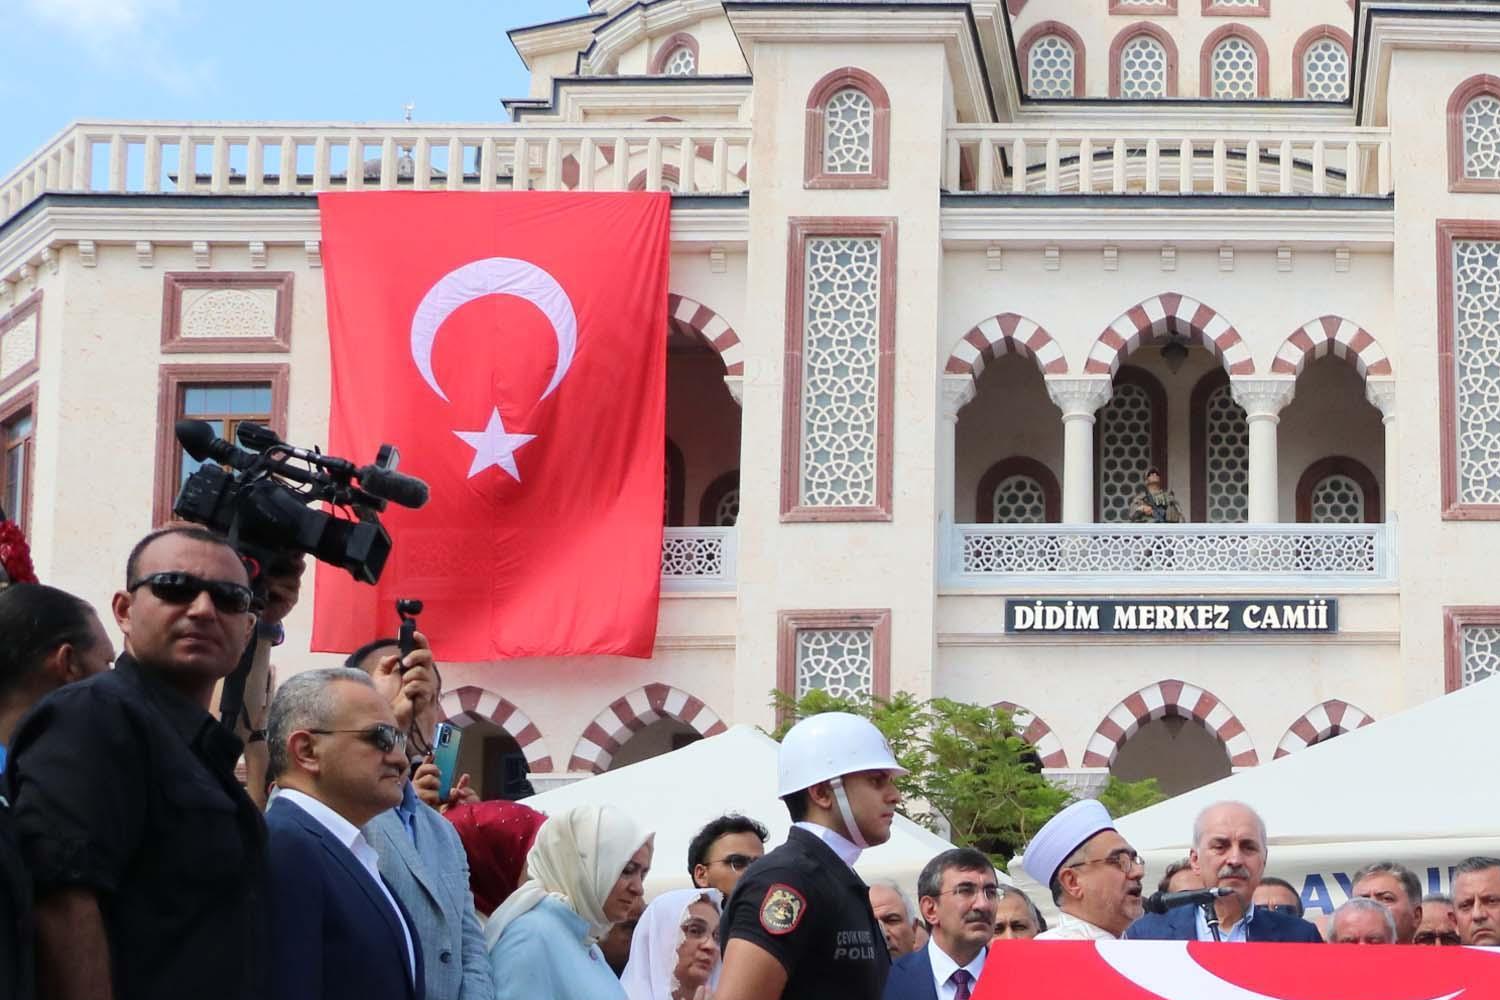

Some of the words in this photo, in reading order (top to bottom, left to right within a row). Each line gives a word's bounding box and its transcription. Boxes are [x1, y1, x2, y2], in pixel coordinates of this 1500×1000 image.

[1014, 600, 1099, 629] DİDİM
[1113, 604, 1229, 629] MERKEZ
[1242, 600, 1328, 629] CAMİİ
